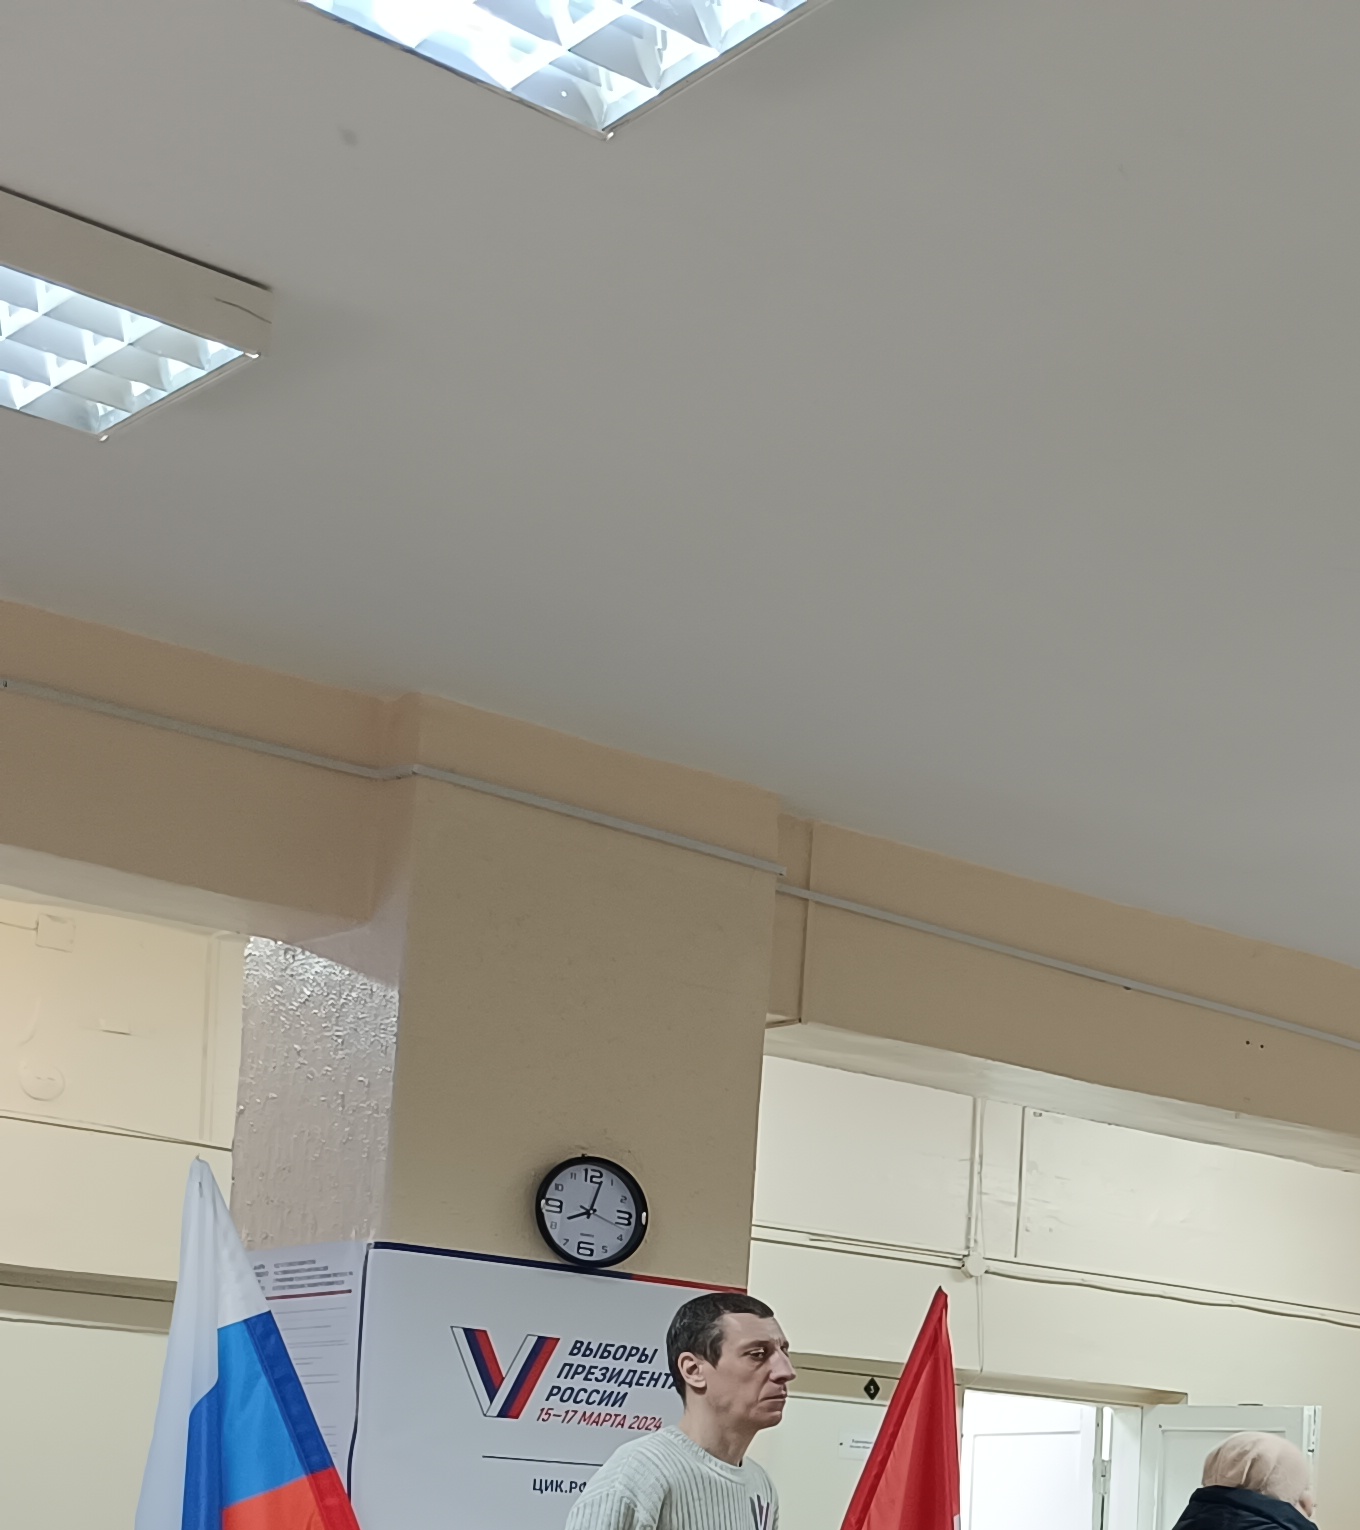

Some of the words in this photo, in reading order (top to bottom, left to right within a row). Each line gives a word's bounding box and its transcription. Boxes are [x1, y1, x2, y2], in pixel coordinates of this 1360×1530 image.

[583, 1168, 604, 1185] 12
[545, 1197, 563, 1214] 9
[620, 1195, 627, 1204] 2
[614, 1210, 633, 1227] 3
[562, 1238, 569, 1246] 7
[576, 1241, 594, 1257] 6
[568, 1339, 659, 1364] ВЫБОРЫ
[545, 1385, 629, 1408] РОССИИ
[577, 1410, 627, 1429] МАРТА
[627, 1415, 664, 1432] 2024
